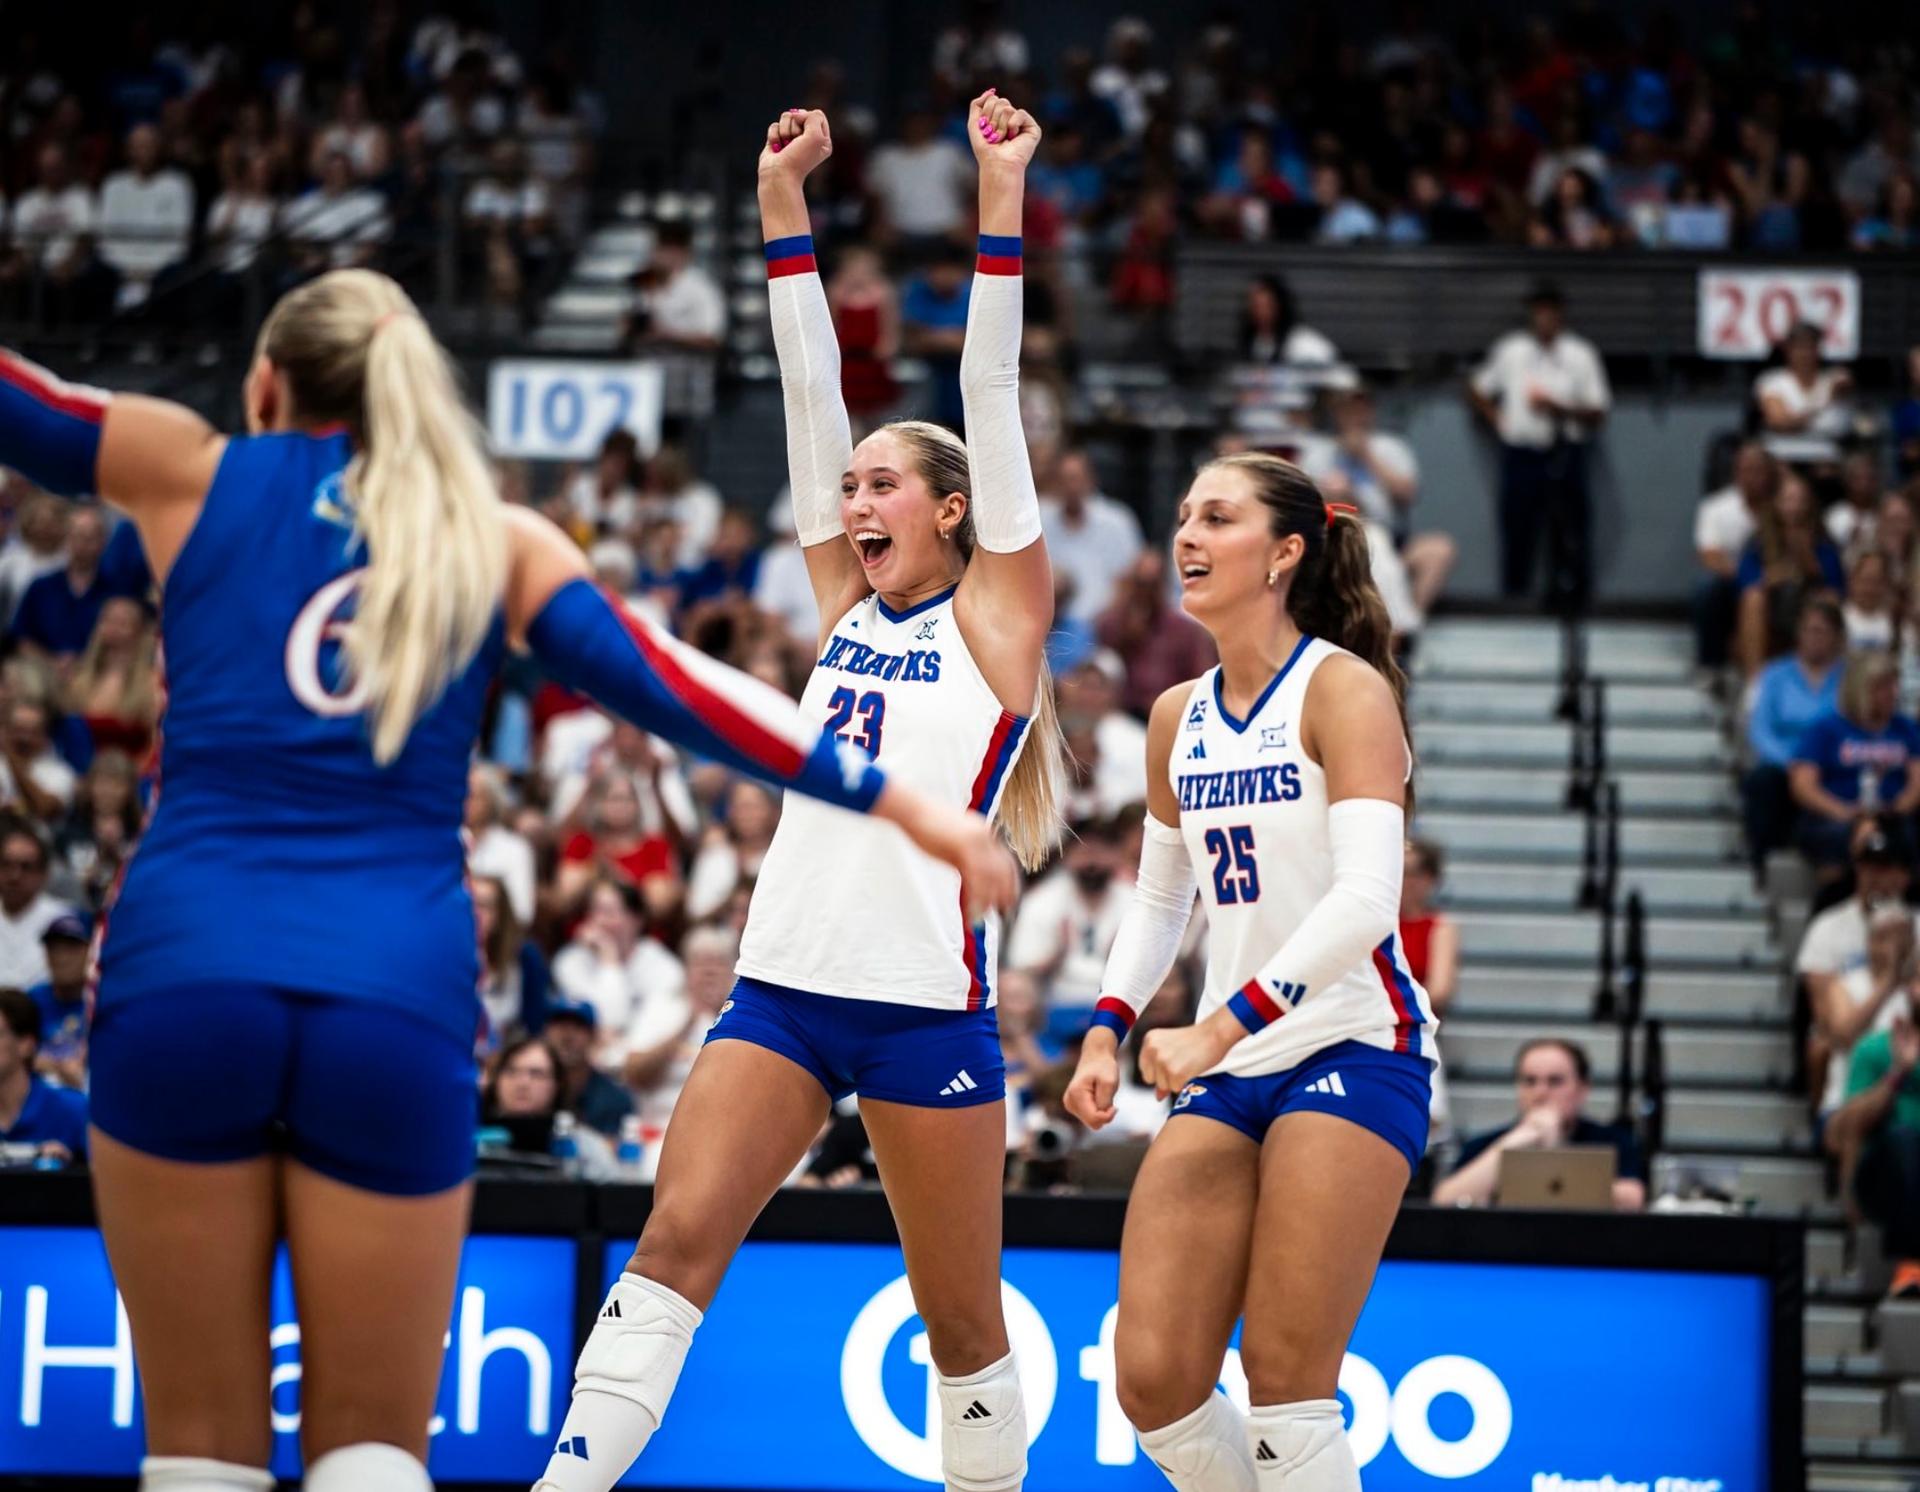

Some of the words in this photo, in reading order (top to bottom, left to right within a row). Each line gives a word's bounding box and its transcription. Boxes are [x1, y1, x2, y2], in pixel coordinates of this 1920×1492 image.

[1717, 282, 1843, 346] 202
[285, 564, 374, 718] 6
[823, 685, 886, 764] 23
[1204, 824, 1261, 906] 25
